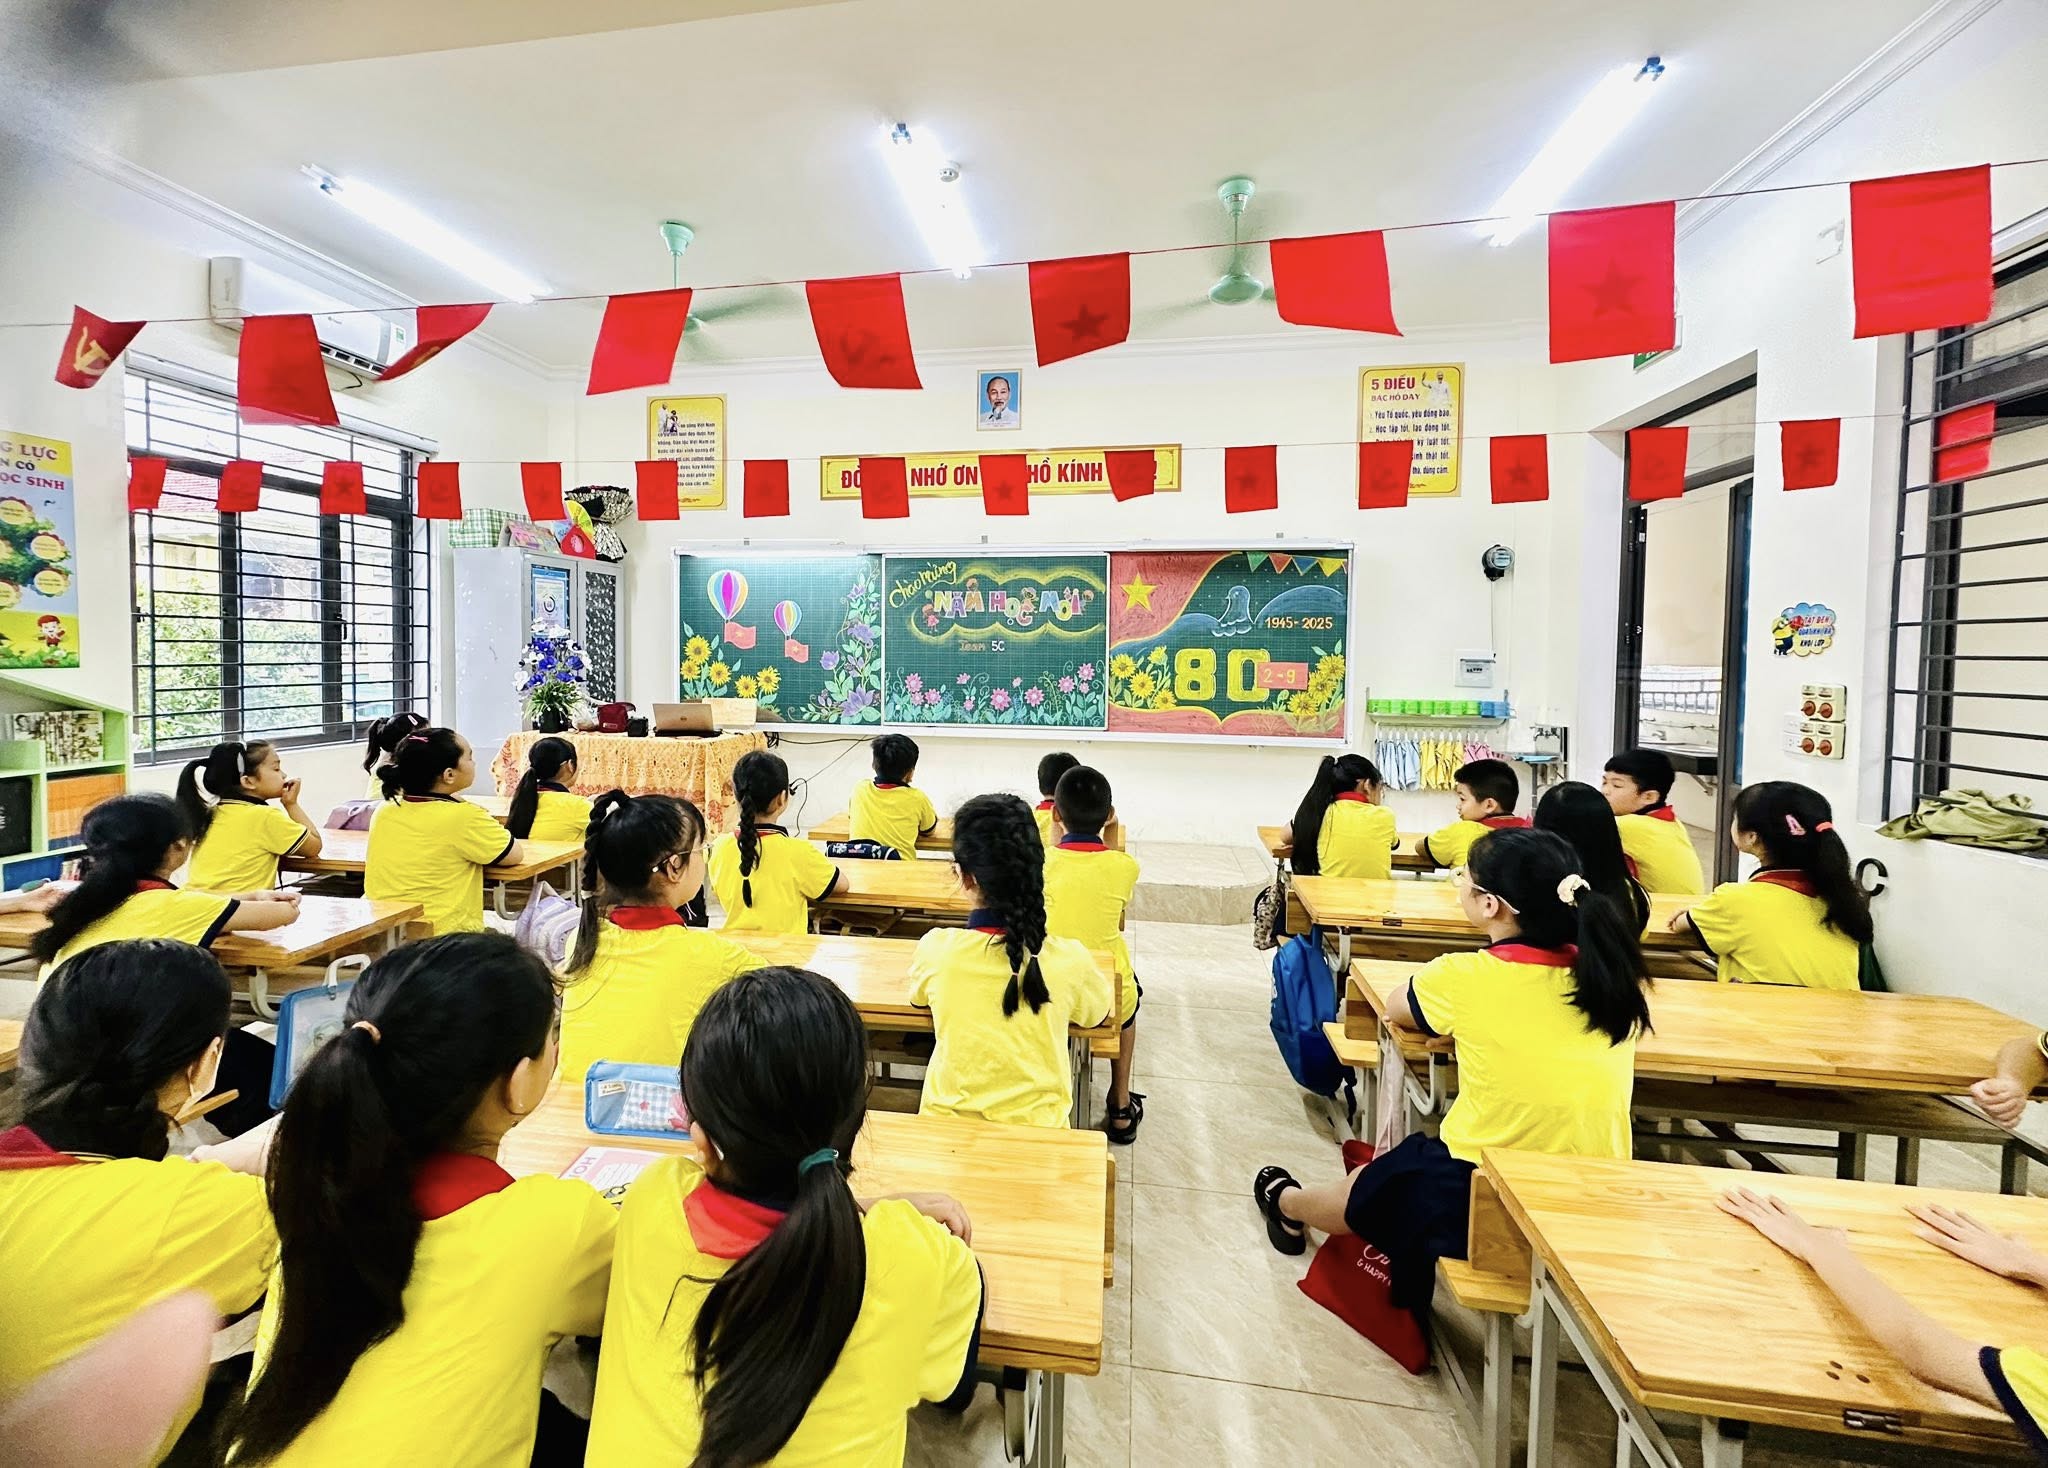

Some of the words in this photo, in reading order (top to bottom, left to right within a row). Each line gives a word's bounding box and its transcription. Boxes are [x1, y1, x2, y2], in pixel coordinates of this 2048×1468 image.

[1372, 379, 1379, 390] 5
[0, 472, 21, 484] ỌC
[26, 476, 64, 490] SINH
[911, 463, 948, 486] NHỚ
[954, 462, 978, 486] ƠN
[1027, 457, 1051, 483] HỒ
[1058, 459, 1102, 482] KÍNH
[934, 590, 985, 618] NĂM
[989, 590, 1033, 626] HỌC
[991, 640, 1005, 652] 5C
[1175, 648, 1271, 702] 80
[1364, 1262, 1389, 1283] HAPPY
